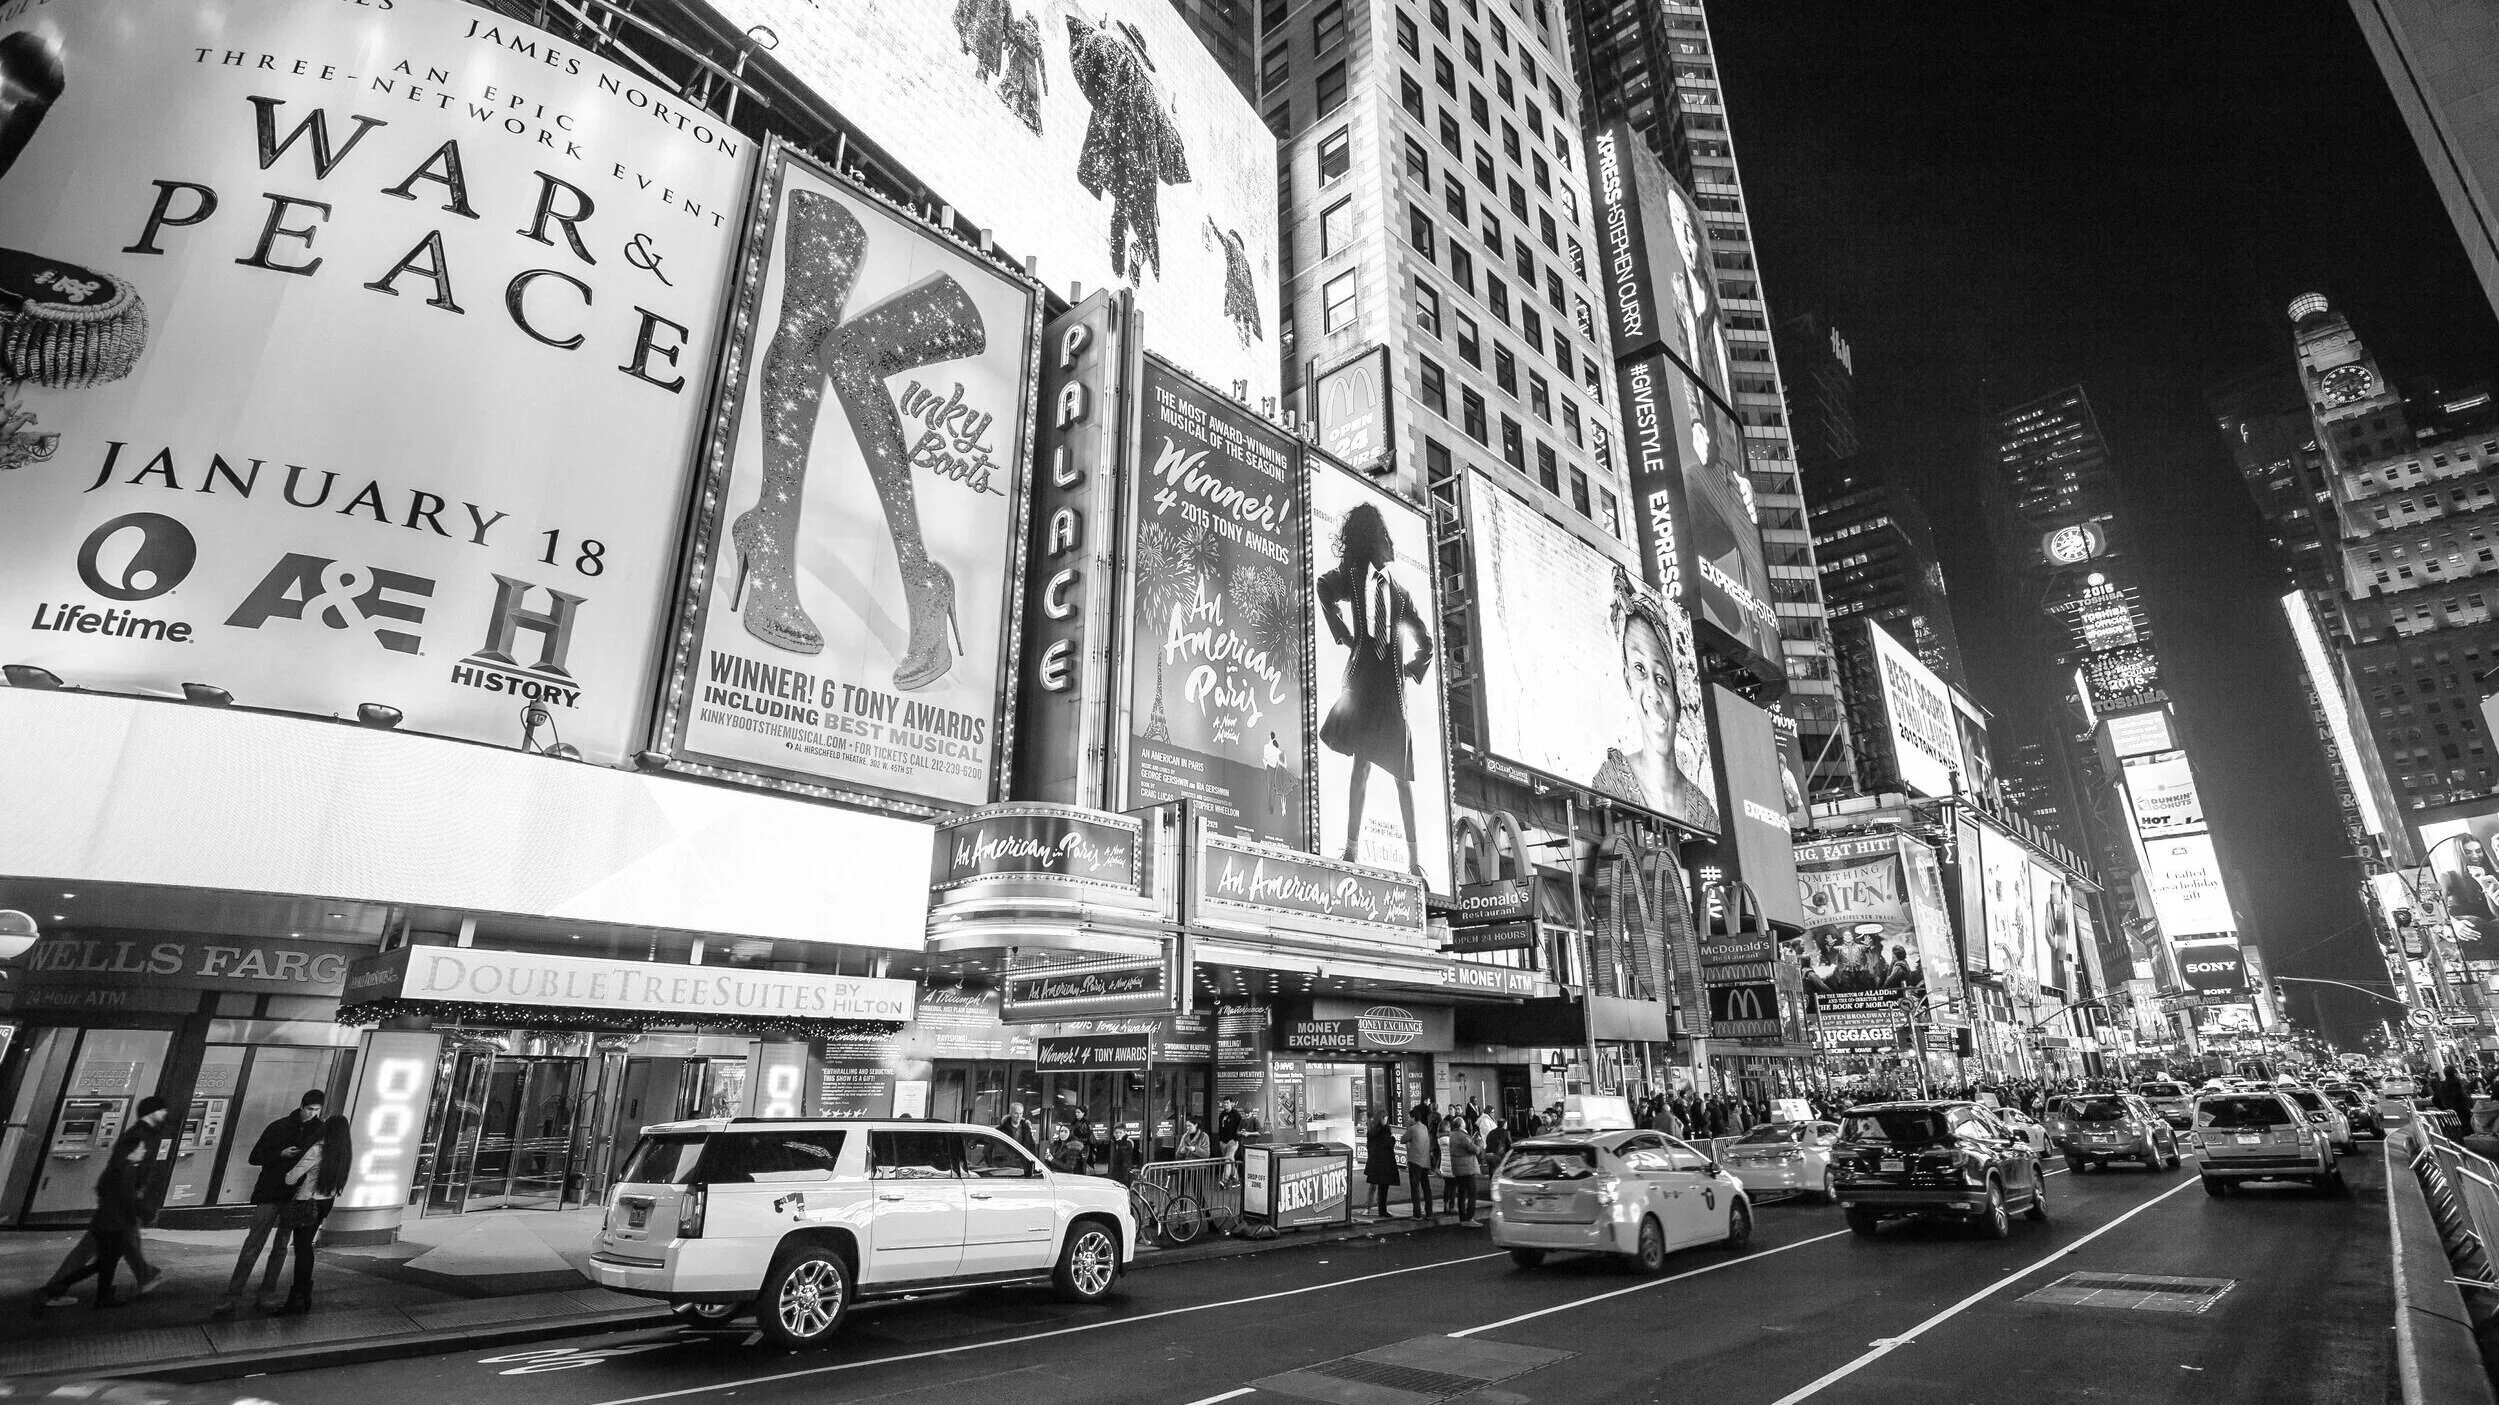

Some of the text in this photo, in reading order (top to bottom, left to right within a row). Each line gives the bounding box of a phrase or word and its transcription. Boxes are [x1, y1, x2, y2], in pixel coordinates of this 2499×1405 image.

[394, 59, 575, 131] AN EPIC
[464, 19, 740, 160] JAMES NORTON
[195, 47, 726, 228] THREE-NETWORK EVENT
[246, 95, 673, 287] WAR &
[122, 179, 691, 395] PEACE
[1618, 282, 1643, 338] CURRY
[1155, 386, 1288, 469] THE MOST AWARD-WINNING
[1328, 412, 1374, 442] OPEN
[1630, 363, 1665, 474] #GIVESTYLE
[1160, 407, 1285, 483] MUSICAL OF THE SEASON!
[1334, 428, 1369, 459] 24
[908, 430, 1005, 496] Boots
[1153, 435, 1290, 535] Winner!
[83, 441, 607, 576] JANUARY 18
[1039, 321, 1092, 692] PALACE
[1153, 487, 1289, 565] 4 2015 TONY AWARDS
[1648, 489, 1683, 600] EXPRESS
[223, 552, 437, 656] A&E
[1189, 573, 1223, 626] An
[2080, 591, 2124, 606] TOSHIBA
[2082, 606, 2128, 623] TOSHIBA
[31, 603, 194, 643] Lifetime
[1163, 601, 1285, 705] American
[1226, 661, 1238, 673] in
[451, 665, 580, 708] HISTORY
[1884, 653, 1914, 702] BEST
[710, 650, 986, 745] WINNER! 6 TONY AWARDS
[1184, 664, 1263, 728] Paris
[2092, 690, 2168, 712] TOSHIBA
[704, 686, 982, 763] INCLUDING BEST MUSICAL
[700, 708, 982, 780] KINKYBOOTSTHEMUSICAL.COM FOR TICKETS CALL 212-239-6200
[795, 743, 802, 751] AL
[1141, 748, 1150, 759] AN
[1151, 750, 1180, 767] AMERICAN
[1181, 758, 1187, 768] IN
[1188, 760, 1204, 772] PARIS
[1141, 769, 1162, 781] GEORGE
[2151, 792, 2192, 805] DUNKIN'
[2152, 799, 2191, 810] DONUTS
[2141, 816, 2171, 824] HOT
[953, 829, 1101, 871] An American Paris
[1822, 844, 1851, 860] FAT
[2351, 827, 2378, 876] YOU
[1217, 855, 1379, 920] An American Paris
[1802, 864, 1879, 882] OMETHING
[1460, 889, 1529, 910] cDonald's
[1462, 906, 1516, 919] Restaurant
[1454, 931, 1526, 944] OPEN 24 HOURS
[1700, 941, 1770, 956] McDonald's
[29, 940, 186, 974] WELLS
[196, 946, 347, 985] FARG
[1712, 952, 1759, 962] Restaurant
[2186, 961, 2236, 973] SONY
[836, 983, 861, 996] BY
[1459, 968, 1501, 987] MONEY
[1509, 975, 1532, 990] ATM
[86, 990, 126, 1006] ATM
[833, 997, 903, 1014] HILTON
[1865, 1000, 1899, 1008] MORMON
[1289, 1034, 1354, 1046] EXCHANGE
[1298, 1022, 1341, 1033] MONEY
[1357, 1019, 1423, 1032] MONEY EXCHANGE
[1815, 1028, 1893, 1042] LUGGAGE
[1039, 1043, 1080, 1065] Winner!
[1081, 1047, 1091, 1064] 4
[1095, 1048, 1113, 1062] TONY
[1115, 1046, 1147, 1061] AWARDS
[1277, 1175, 1320, 1213] JERSEY
[1322, 1168, 1347, 1200] BOYS
